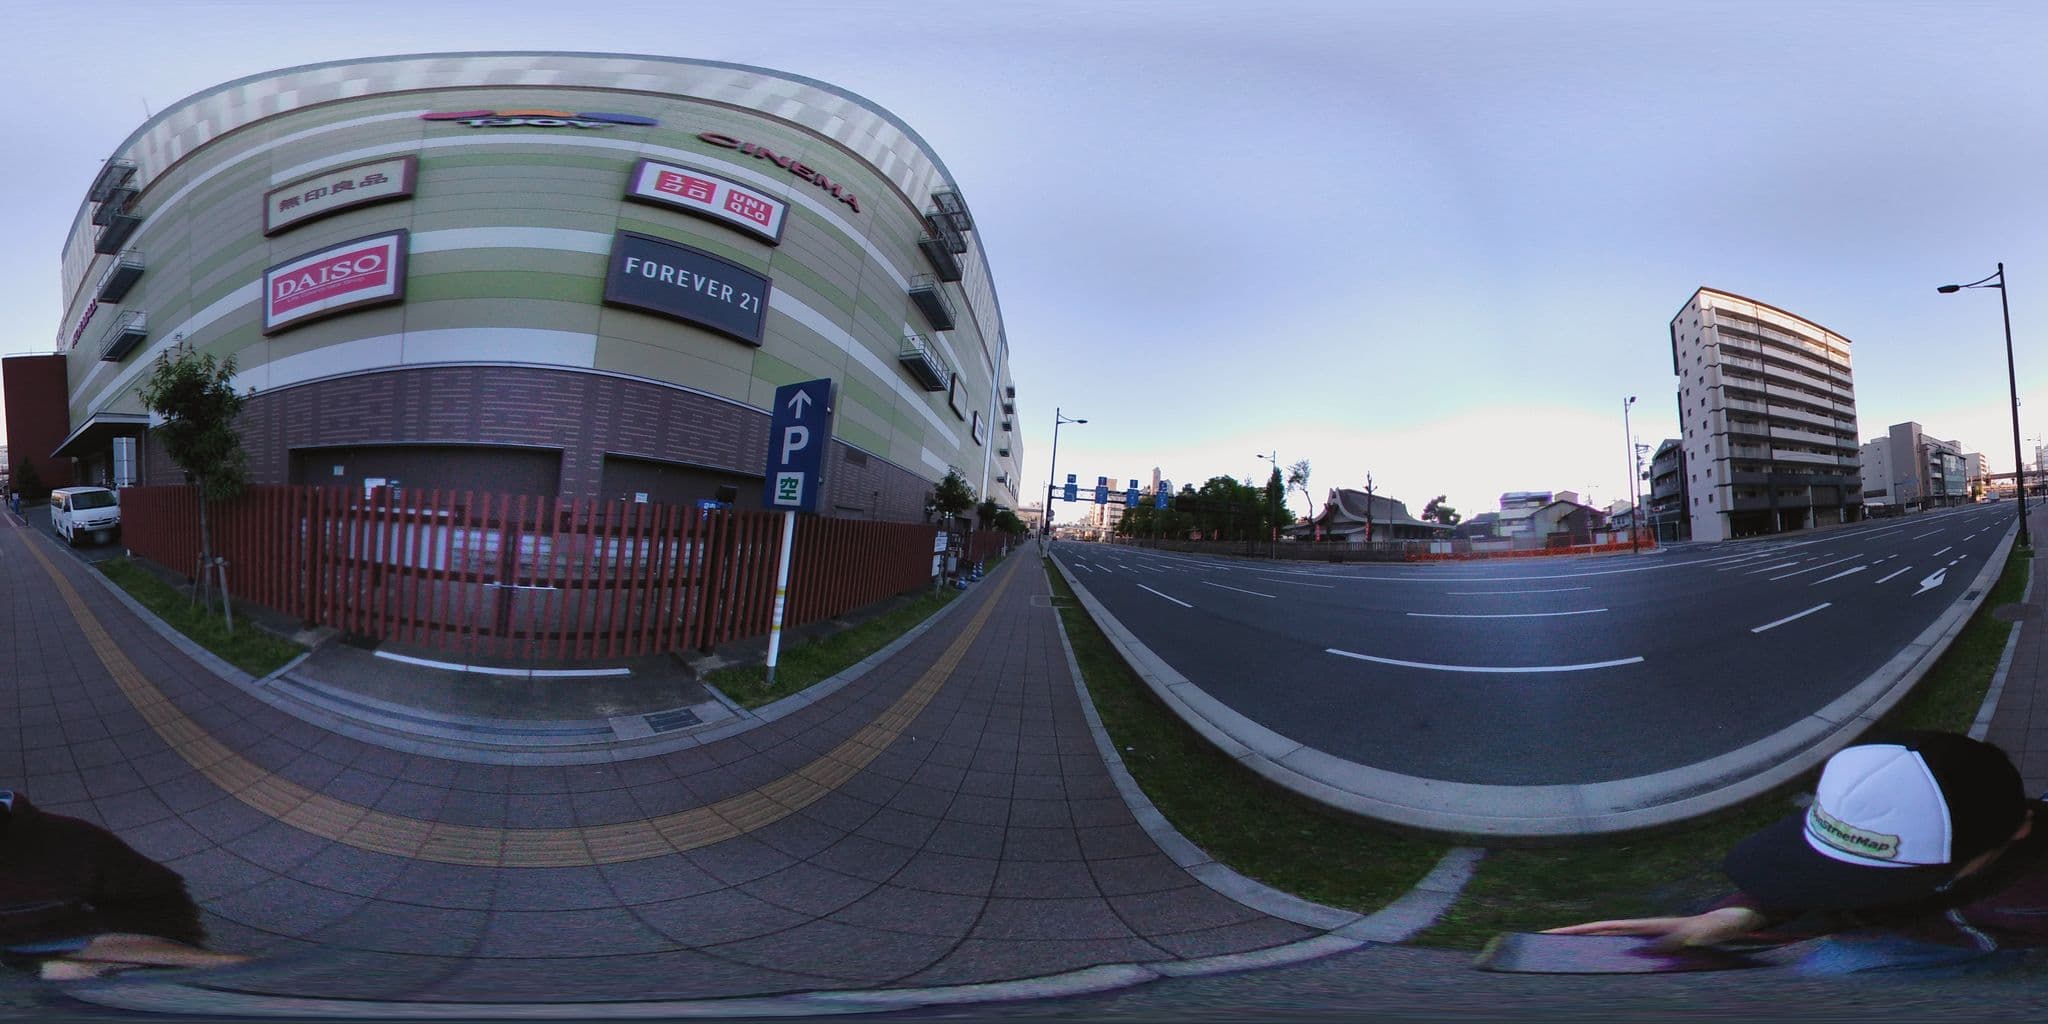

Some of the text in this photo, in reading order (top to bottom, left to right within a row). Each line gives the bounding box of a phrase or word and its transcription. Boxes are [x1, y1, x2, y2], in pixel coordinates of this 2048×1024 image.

[279, 173, 388, 212] 無印良品
[697, 131, 861, 213] CINEMA
[277, 254, 381, 299] DAISO
[625, 256, 759, 314] FOREVER 21
[781, 425, 809, 465] P
[778, 477, 799, 501] 空
